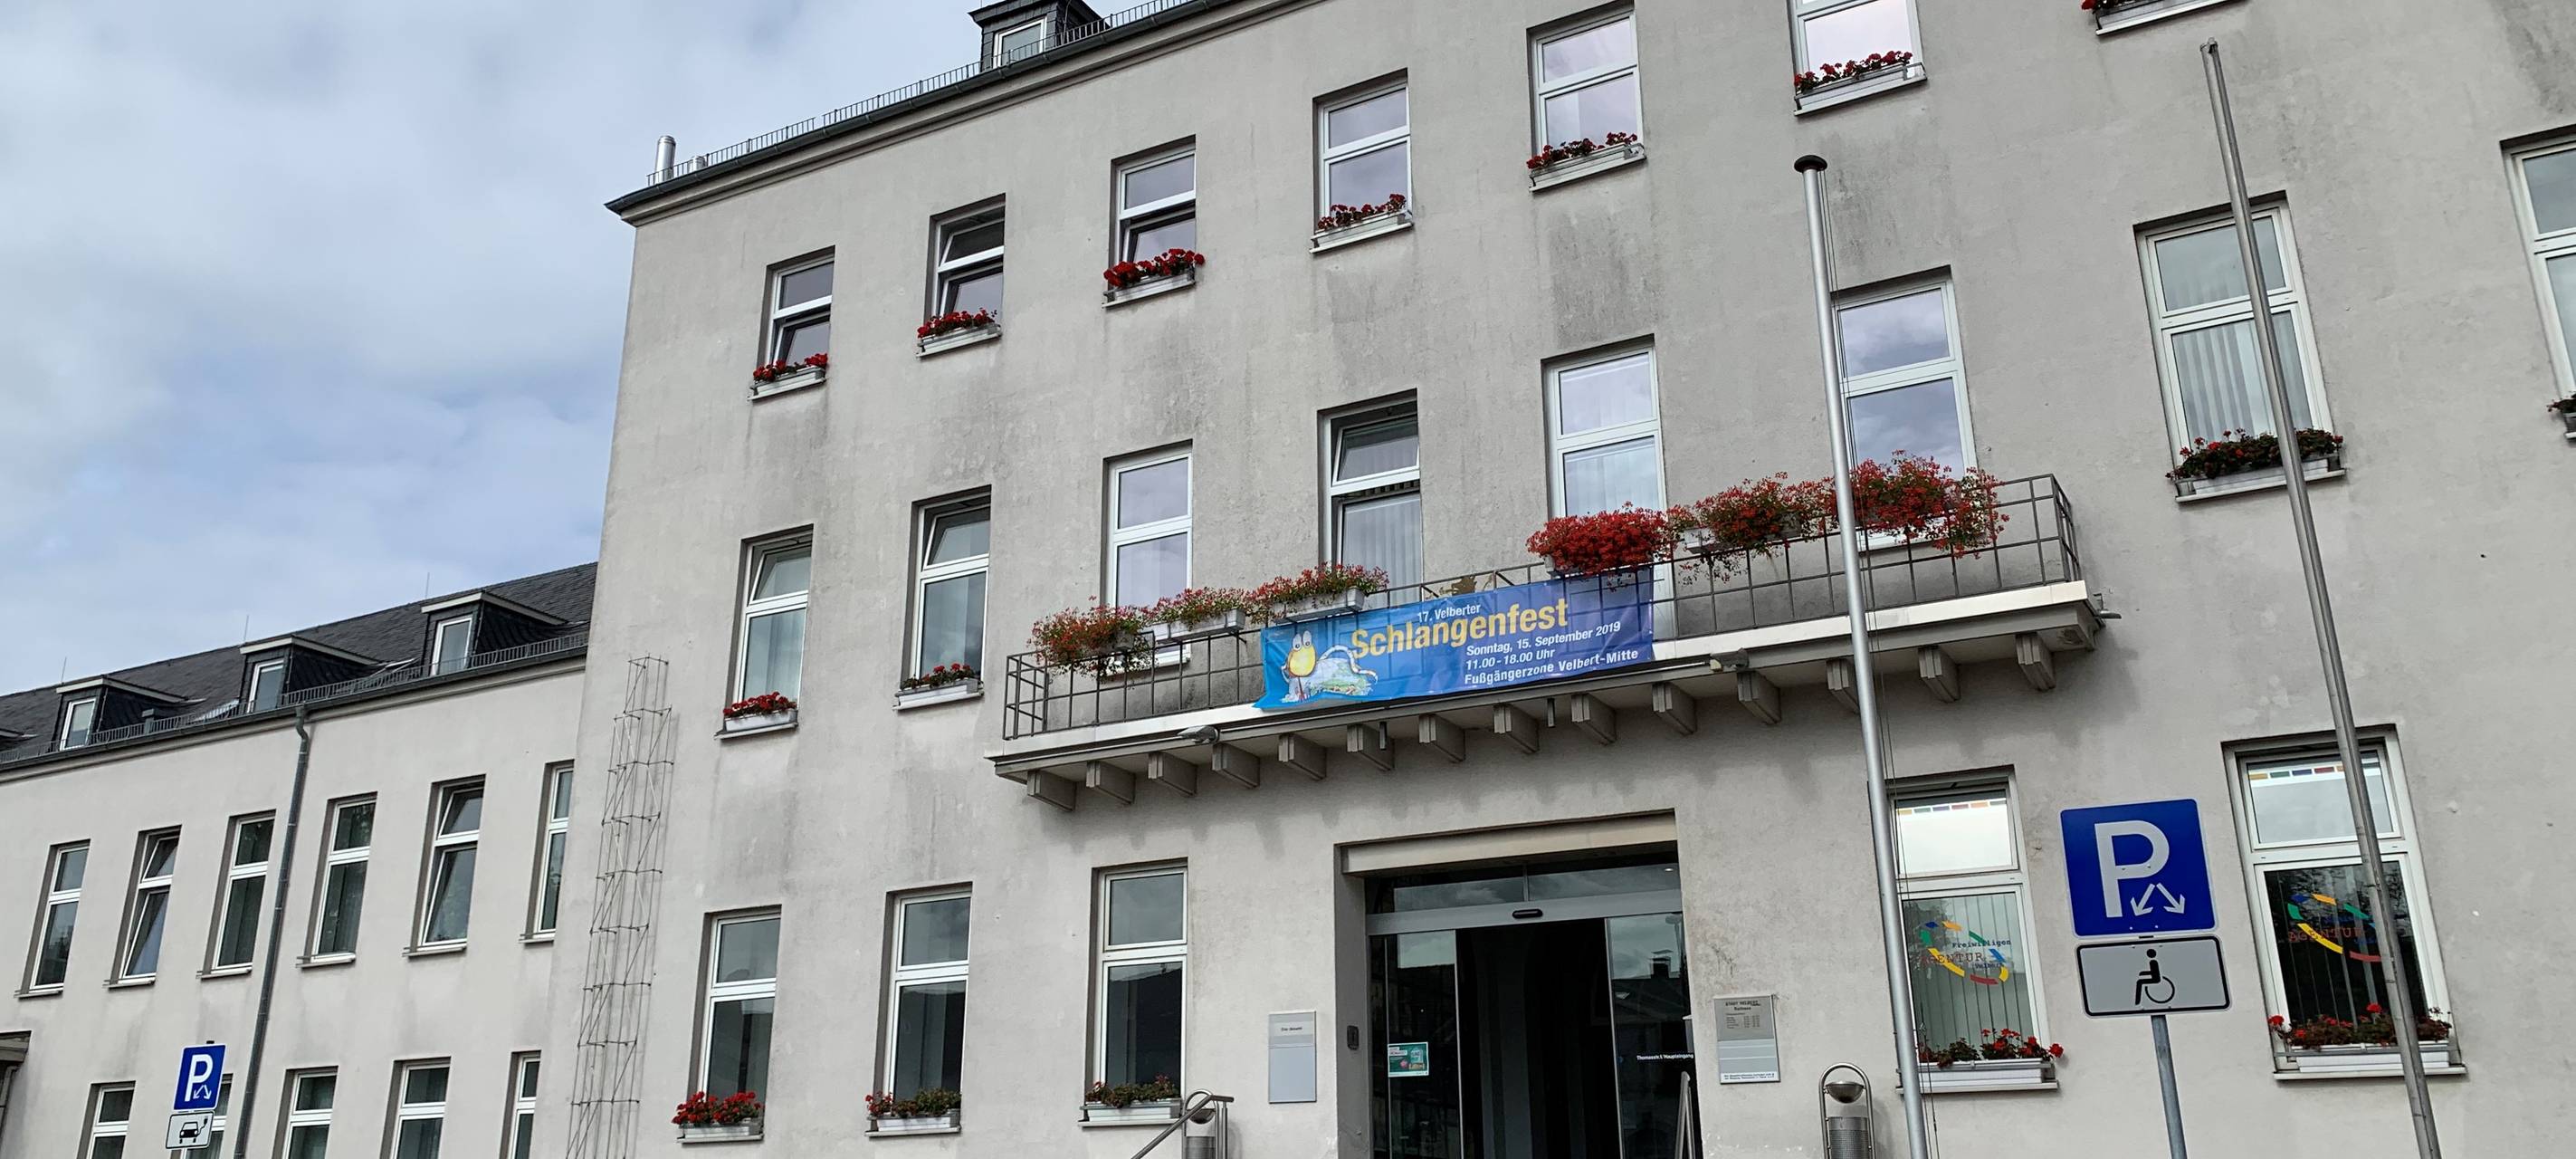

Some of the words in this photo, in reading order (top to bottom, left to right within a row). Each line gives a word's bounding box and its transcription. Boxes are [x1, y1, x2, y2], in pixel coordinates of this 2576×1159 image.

[1351, 599, 1569, 659] Schlangenfest
[1418, 611, 1433, 623] 17.
[1435, 604, 1481, 620] Velberter
[1466, 642, 1512, 656] Sonntag,
[1517, 639, 1531, 650] 15.
[1535, 630, 1593, 647] September
[1596, 621, 1621, 637] 2019
[1536, 648, 1555, 661] Uhr
[1465, 663, 1554, 685] Fußgängerzone
[1559, 649, 1638, 672] Velbert-Mitte
[2094, 819, 2170, 918] P
[185, 1054, 214, 1102] P
